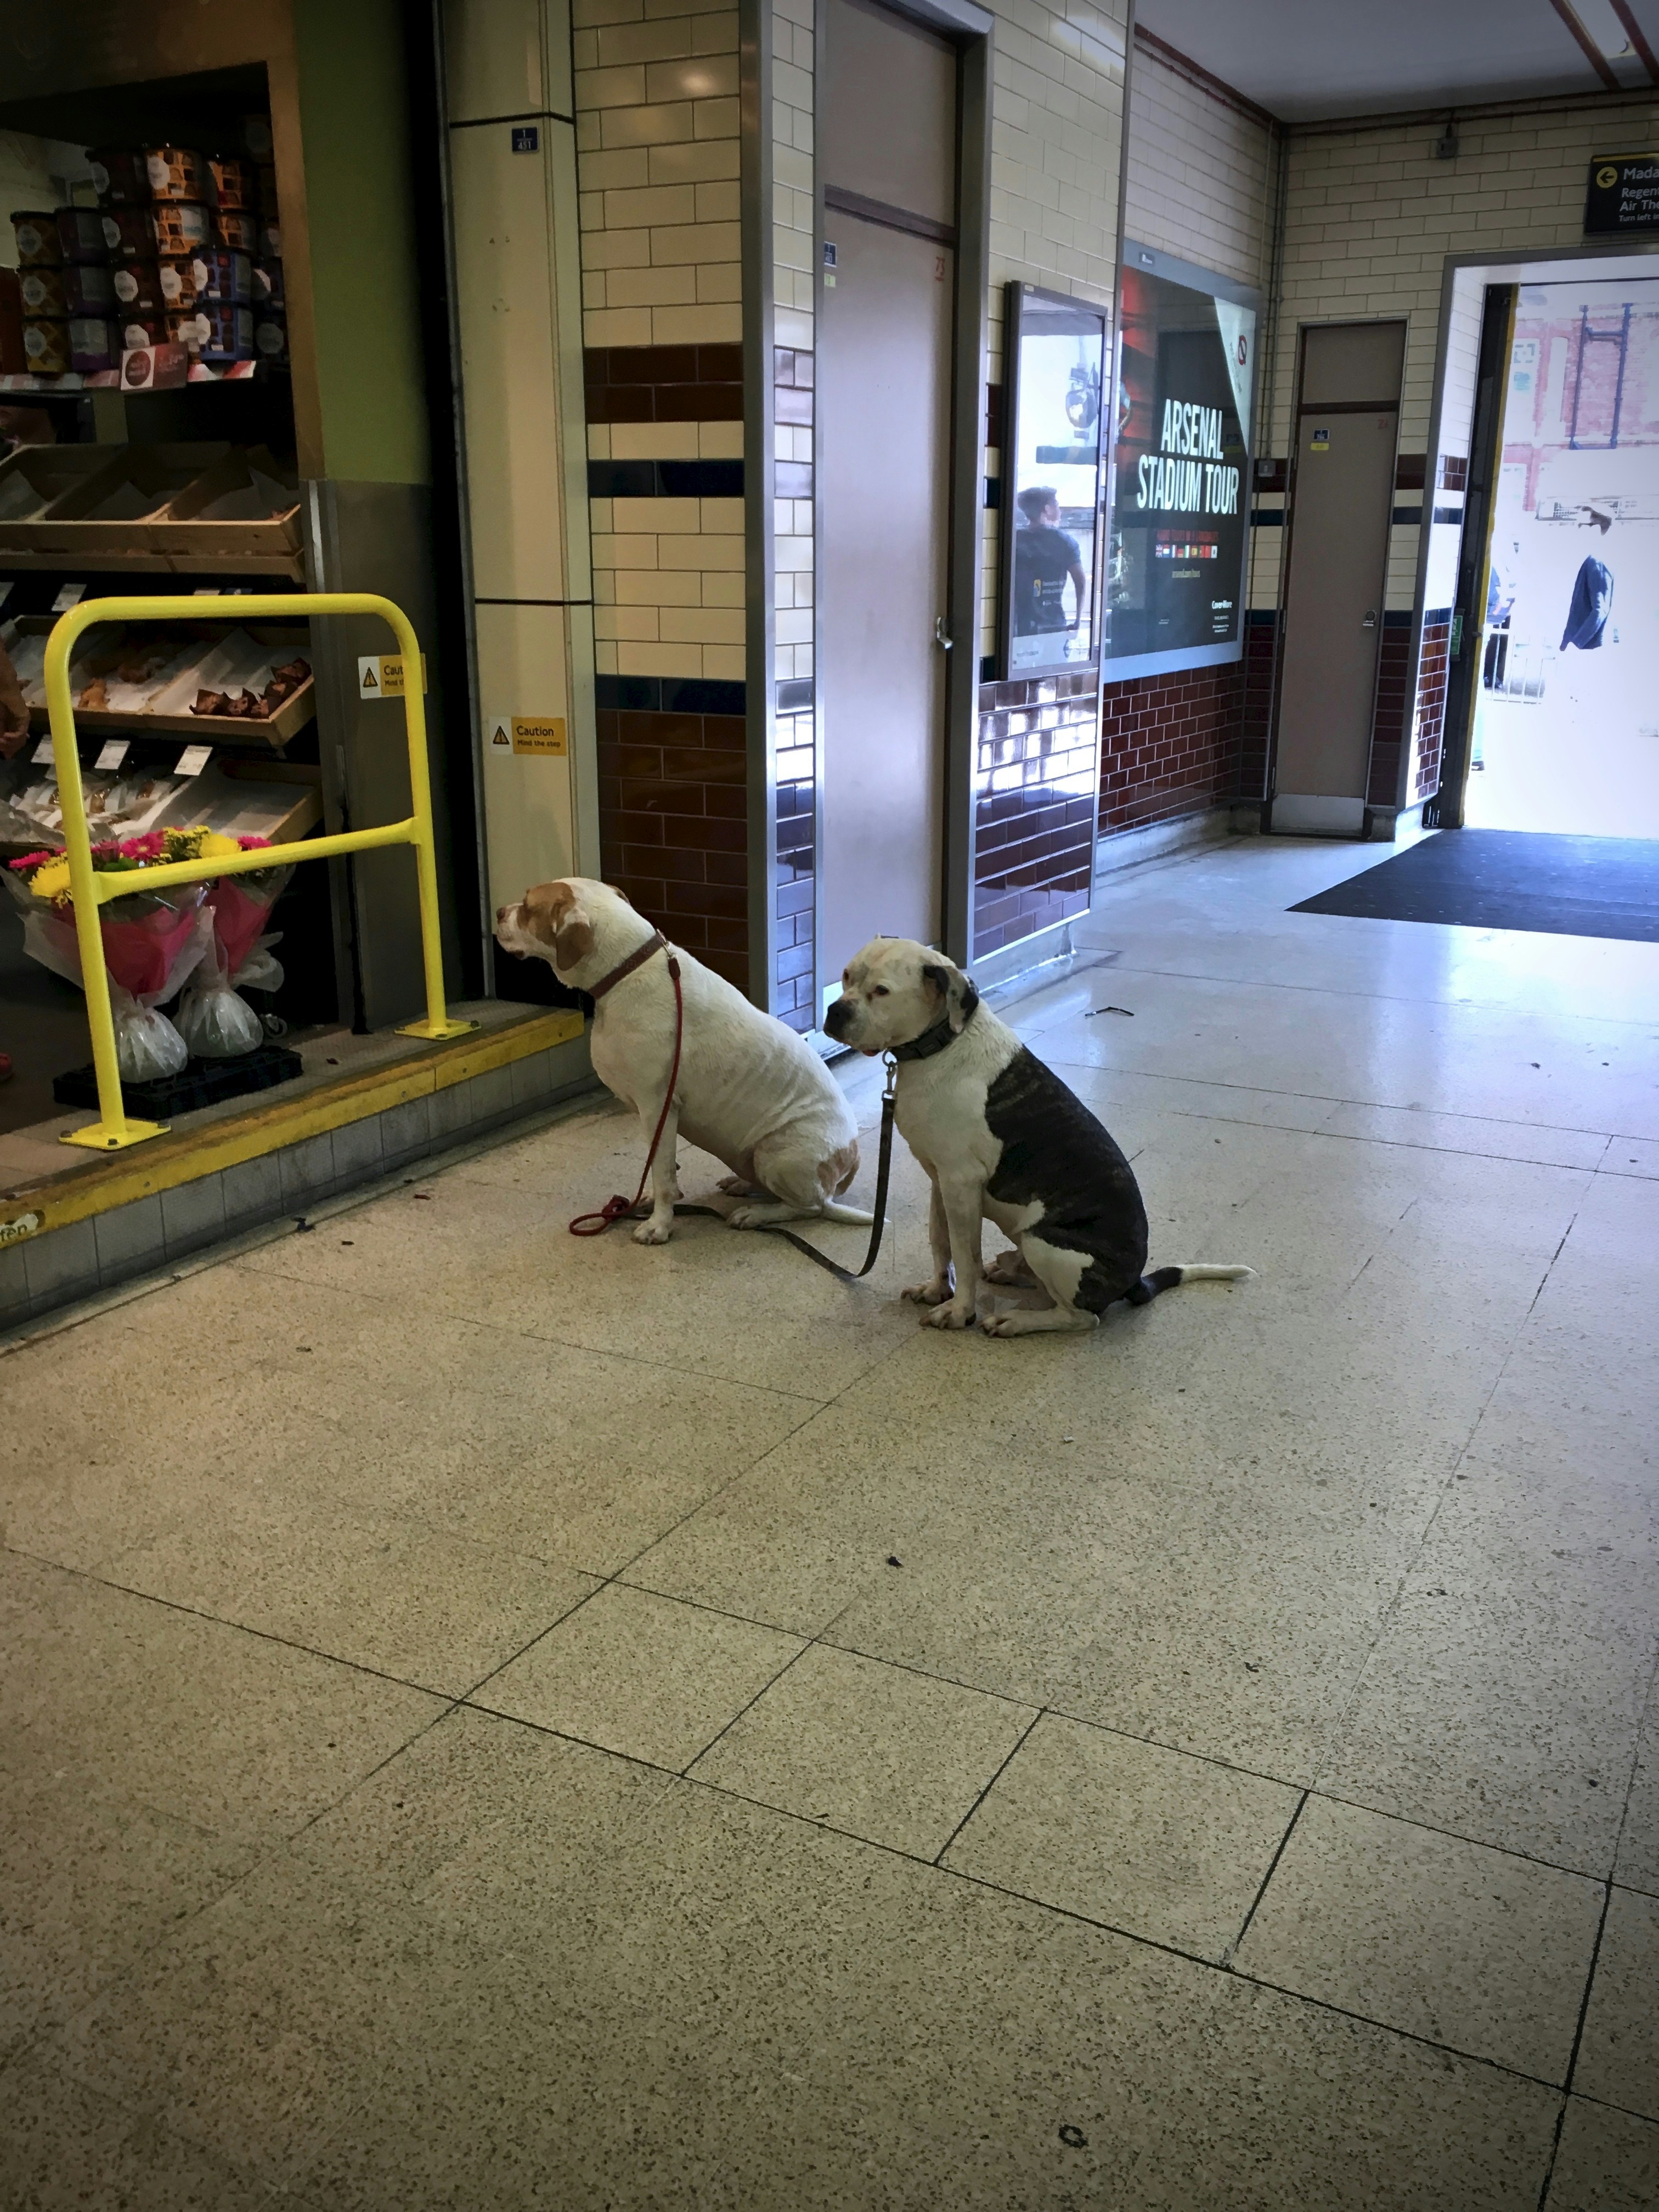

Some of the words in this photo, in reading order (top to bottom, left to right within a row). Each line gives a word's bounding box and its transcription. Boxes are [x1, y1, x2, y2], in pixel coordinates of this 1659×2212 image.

[1619, 200, 1638, 212] Air
[1161, 398, 1224, 460] ARSENAL
[1137, 454, 1203, 512] STADIUM
[1205, 463, 1239, 515] TOUR
[383, 664, 404, 675] Caut
[516, 725, 555, 737] Caution
